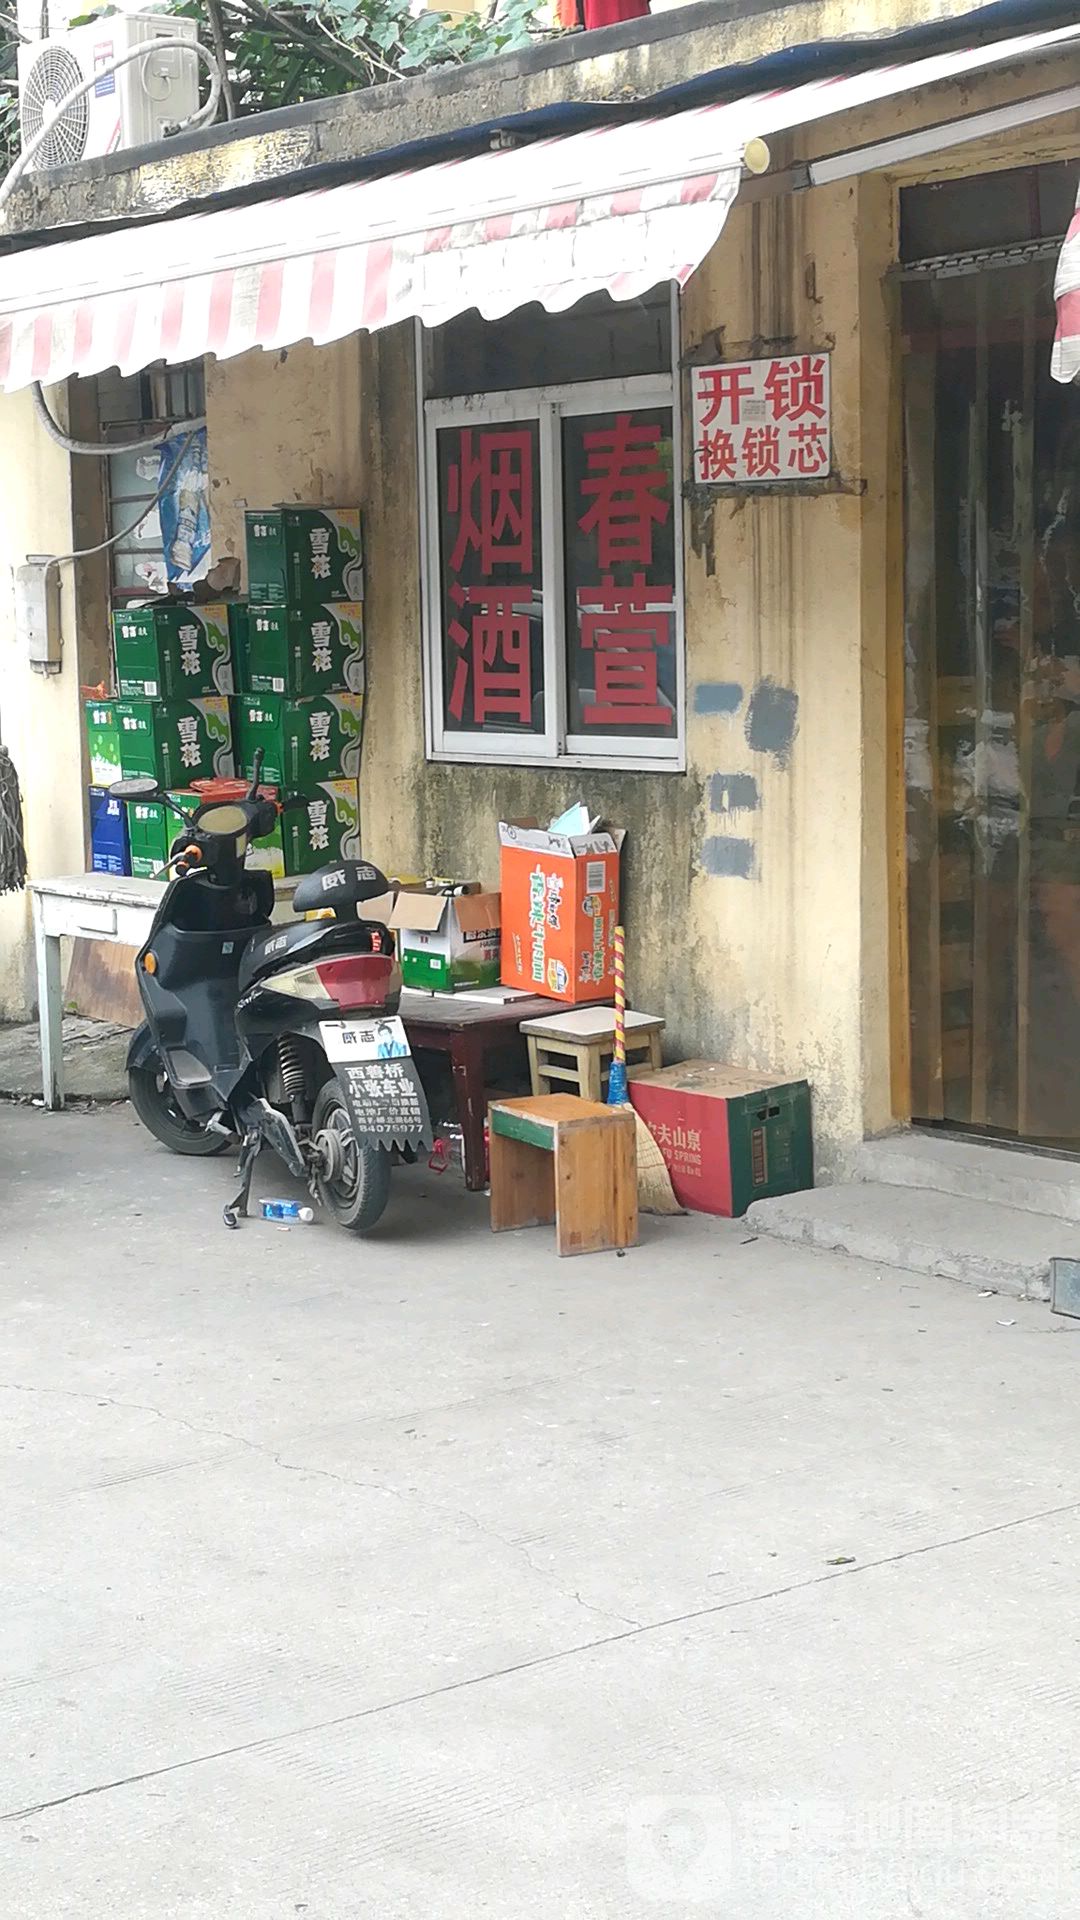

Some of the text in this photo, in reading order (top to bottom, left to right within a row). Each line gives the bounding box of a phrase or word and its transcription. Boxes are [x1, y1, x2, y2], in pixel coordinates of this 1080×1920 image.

[697, 356, 827, 427] 开锁
[698, 422, 828, 480] 换锁芯
[309, 527, 332, 579] 雪花
[447, 428, 533, 723] 烟酒
[577, 414, 673, 726] 春萱
[178, 624, 201, 676] 雪花
[310, 621, 333, 672] 雪花
[177, 716, 202, 768] 雪花
[308, 711, 331, 761] 雪花
[307, 800, 330, 851] 雪花
[344, 1063, 404, 1079] 西善桥
[349, 1078, 417, 1098] 小张车业
